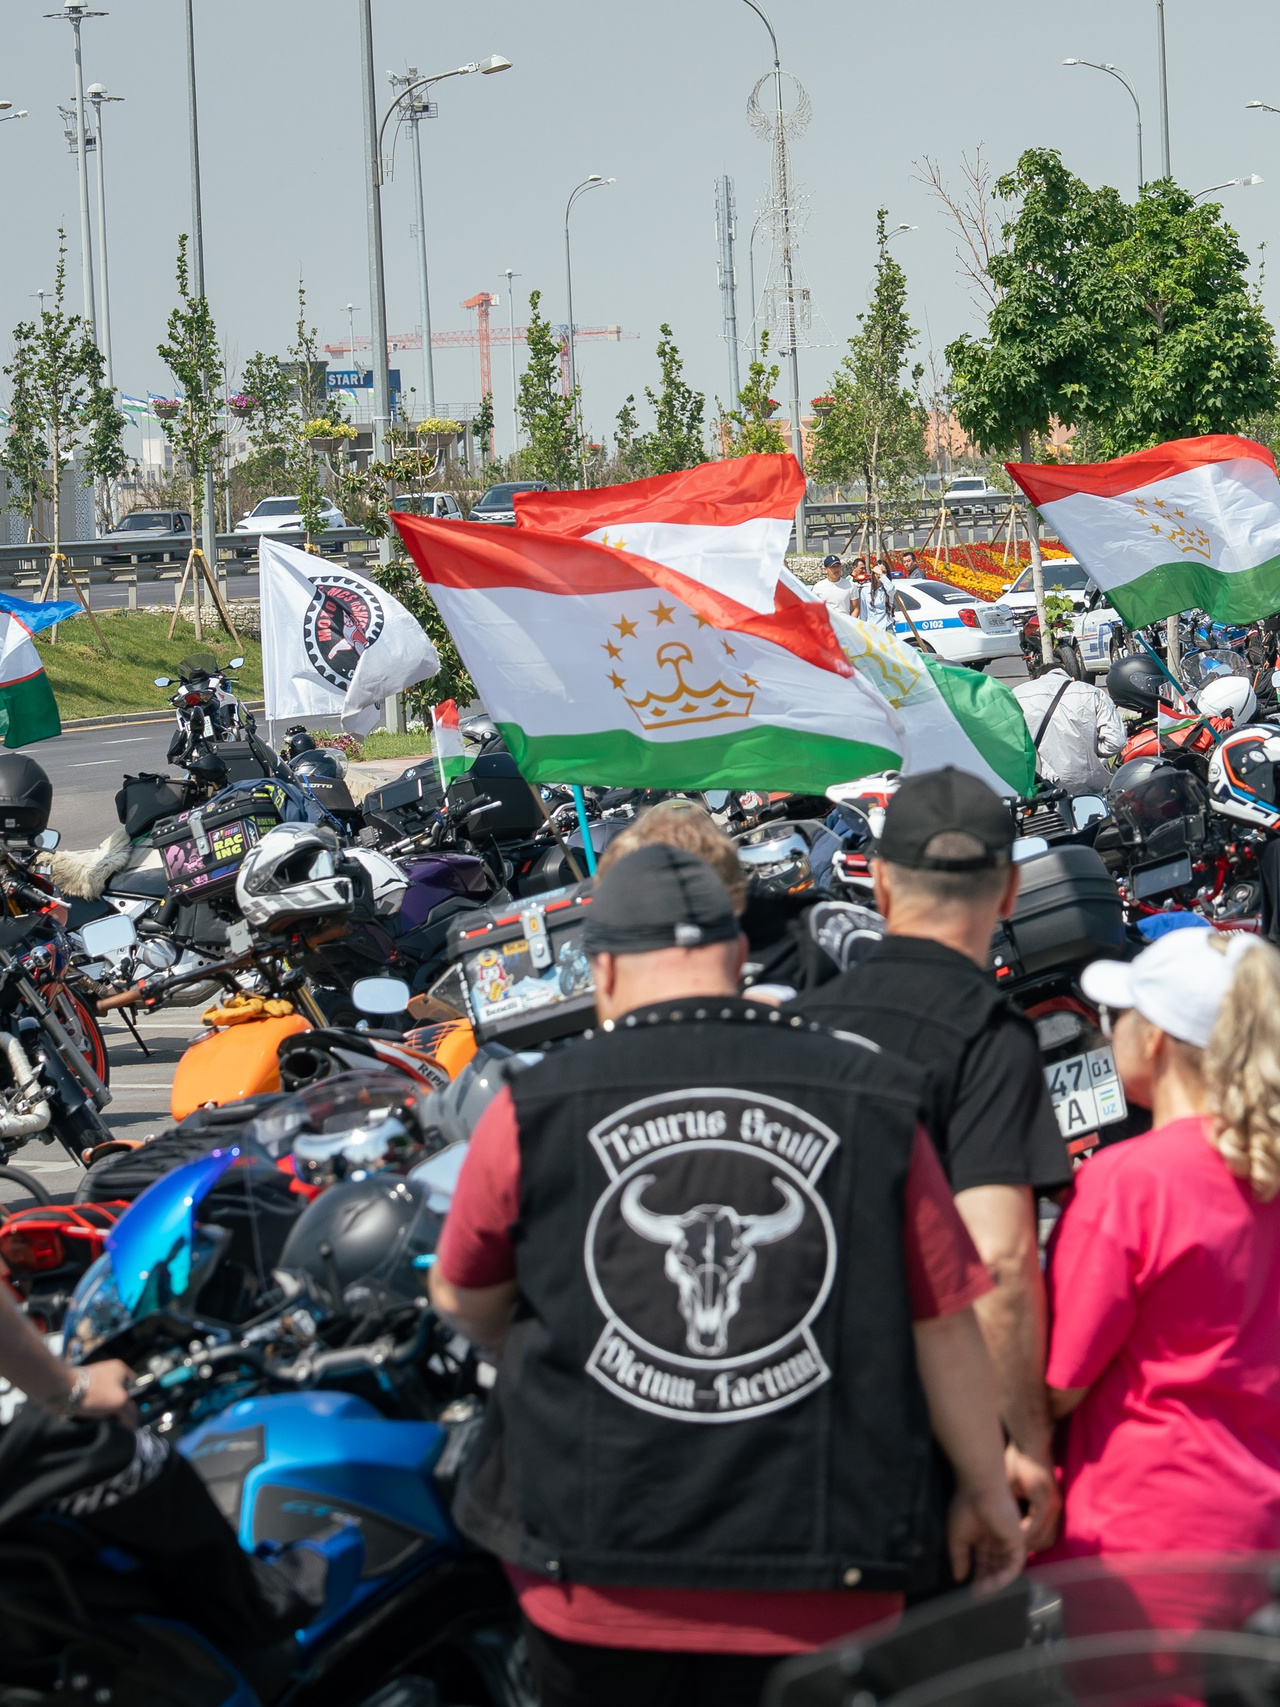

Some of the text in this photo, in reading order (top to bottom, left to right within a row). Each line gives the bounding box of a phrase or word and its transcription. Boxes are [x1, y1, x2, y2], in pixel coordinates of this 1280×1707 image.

[328, 373, 365, 386] START
[317, 600, 337, 642] MOTO
[929, 620, 944, 629] 102
[213, 833, 244, 851] RAC
[215, 846, 242, 860] ING
[1091, 1059, 1112, 1078] 01
[1050, 1059, 1084, 1097] 47
[1054, 1098, 1087, 1130] A
[1103, 1102, 1117, 1116] UZ
[602, 1110, 727, 1163] Taurus
